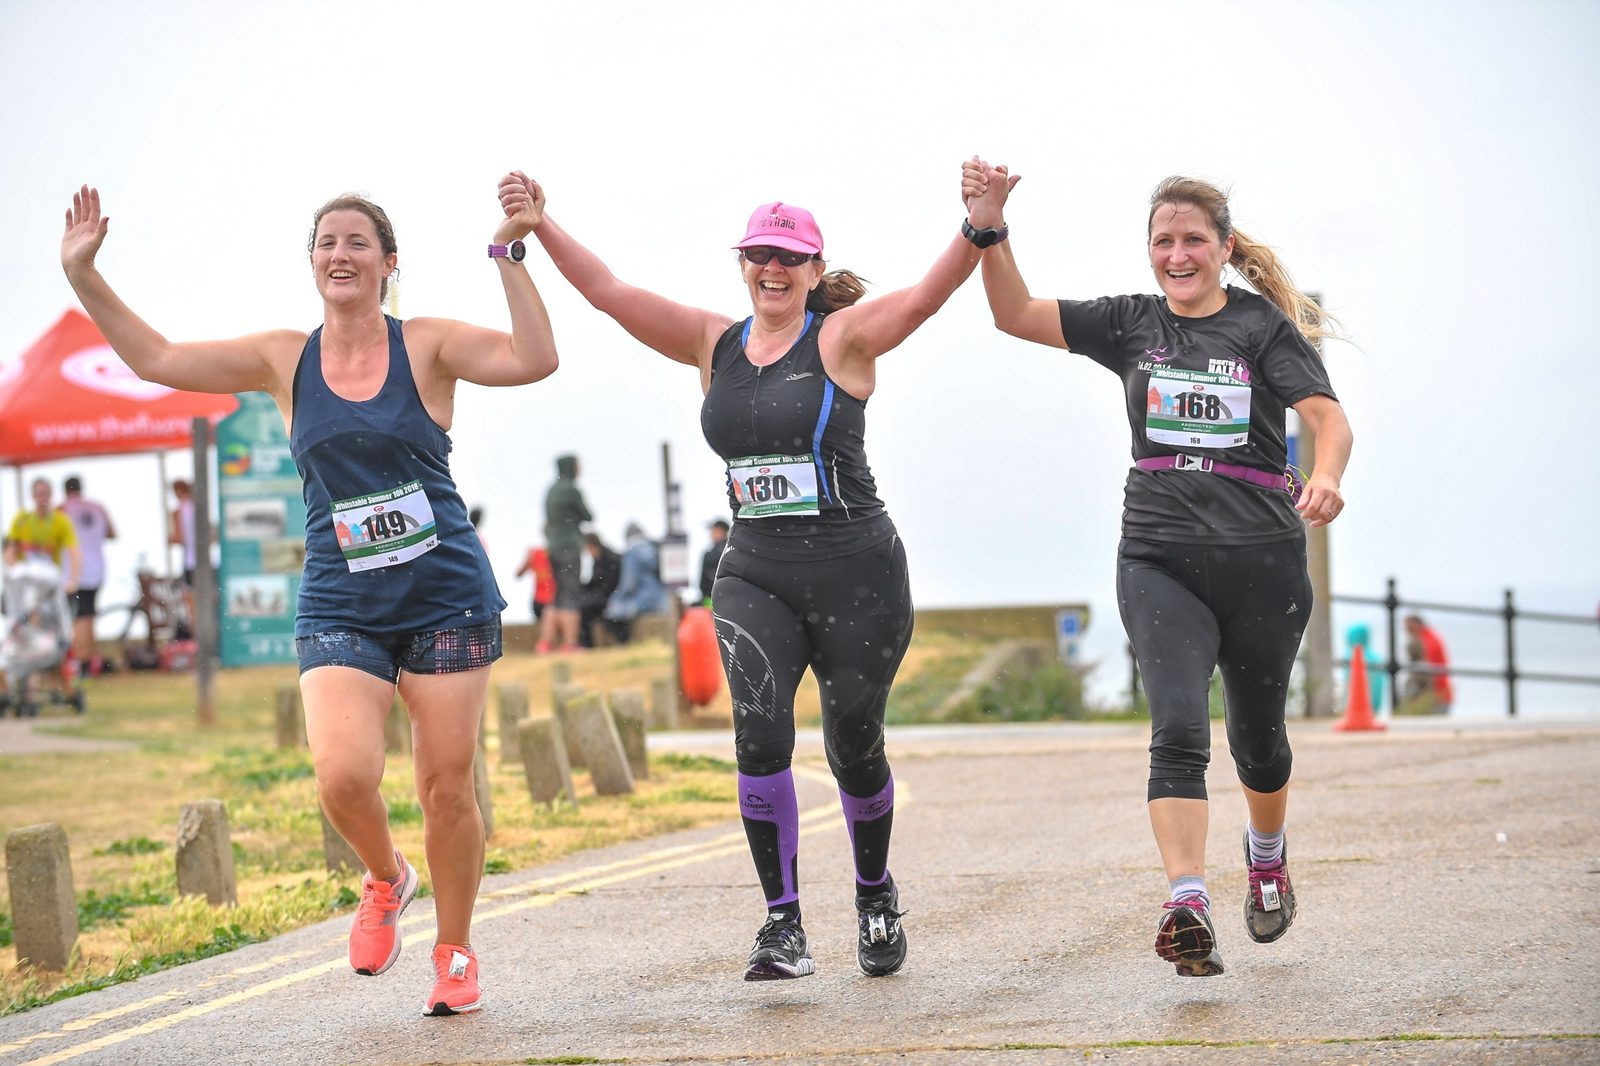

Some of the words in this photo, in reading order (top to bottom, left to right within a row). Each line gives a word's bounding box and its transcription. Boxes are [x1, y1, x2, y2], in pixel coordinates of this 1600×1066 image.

[1156, 369, 1190, 380] Whitstable
[1190, 373, 1217, 383] Summer
[1208, 364, 1236, 376] HALF
[1174, 391, 1220, 420] 168
[754, 457, 781, 465] Summer
[334, 498, 368, 511] Whitstable
[367, 493, 393, 504] Summer
[392, 489, 404, 498] 10k
[403, 482, 419, 494] 2018
[745, 474, 788, 503] 130
[360, 510, 407, 542] 149
[388, 555, 399, 563] 149
